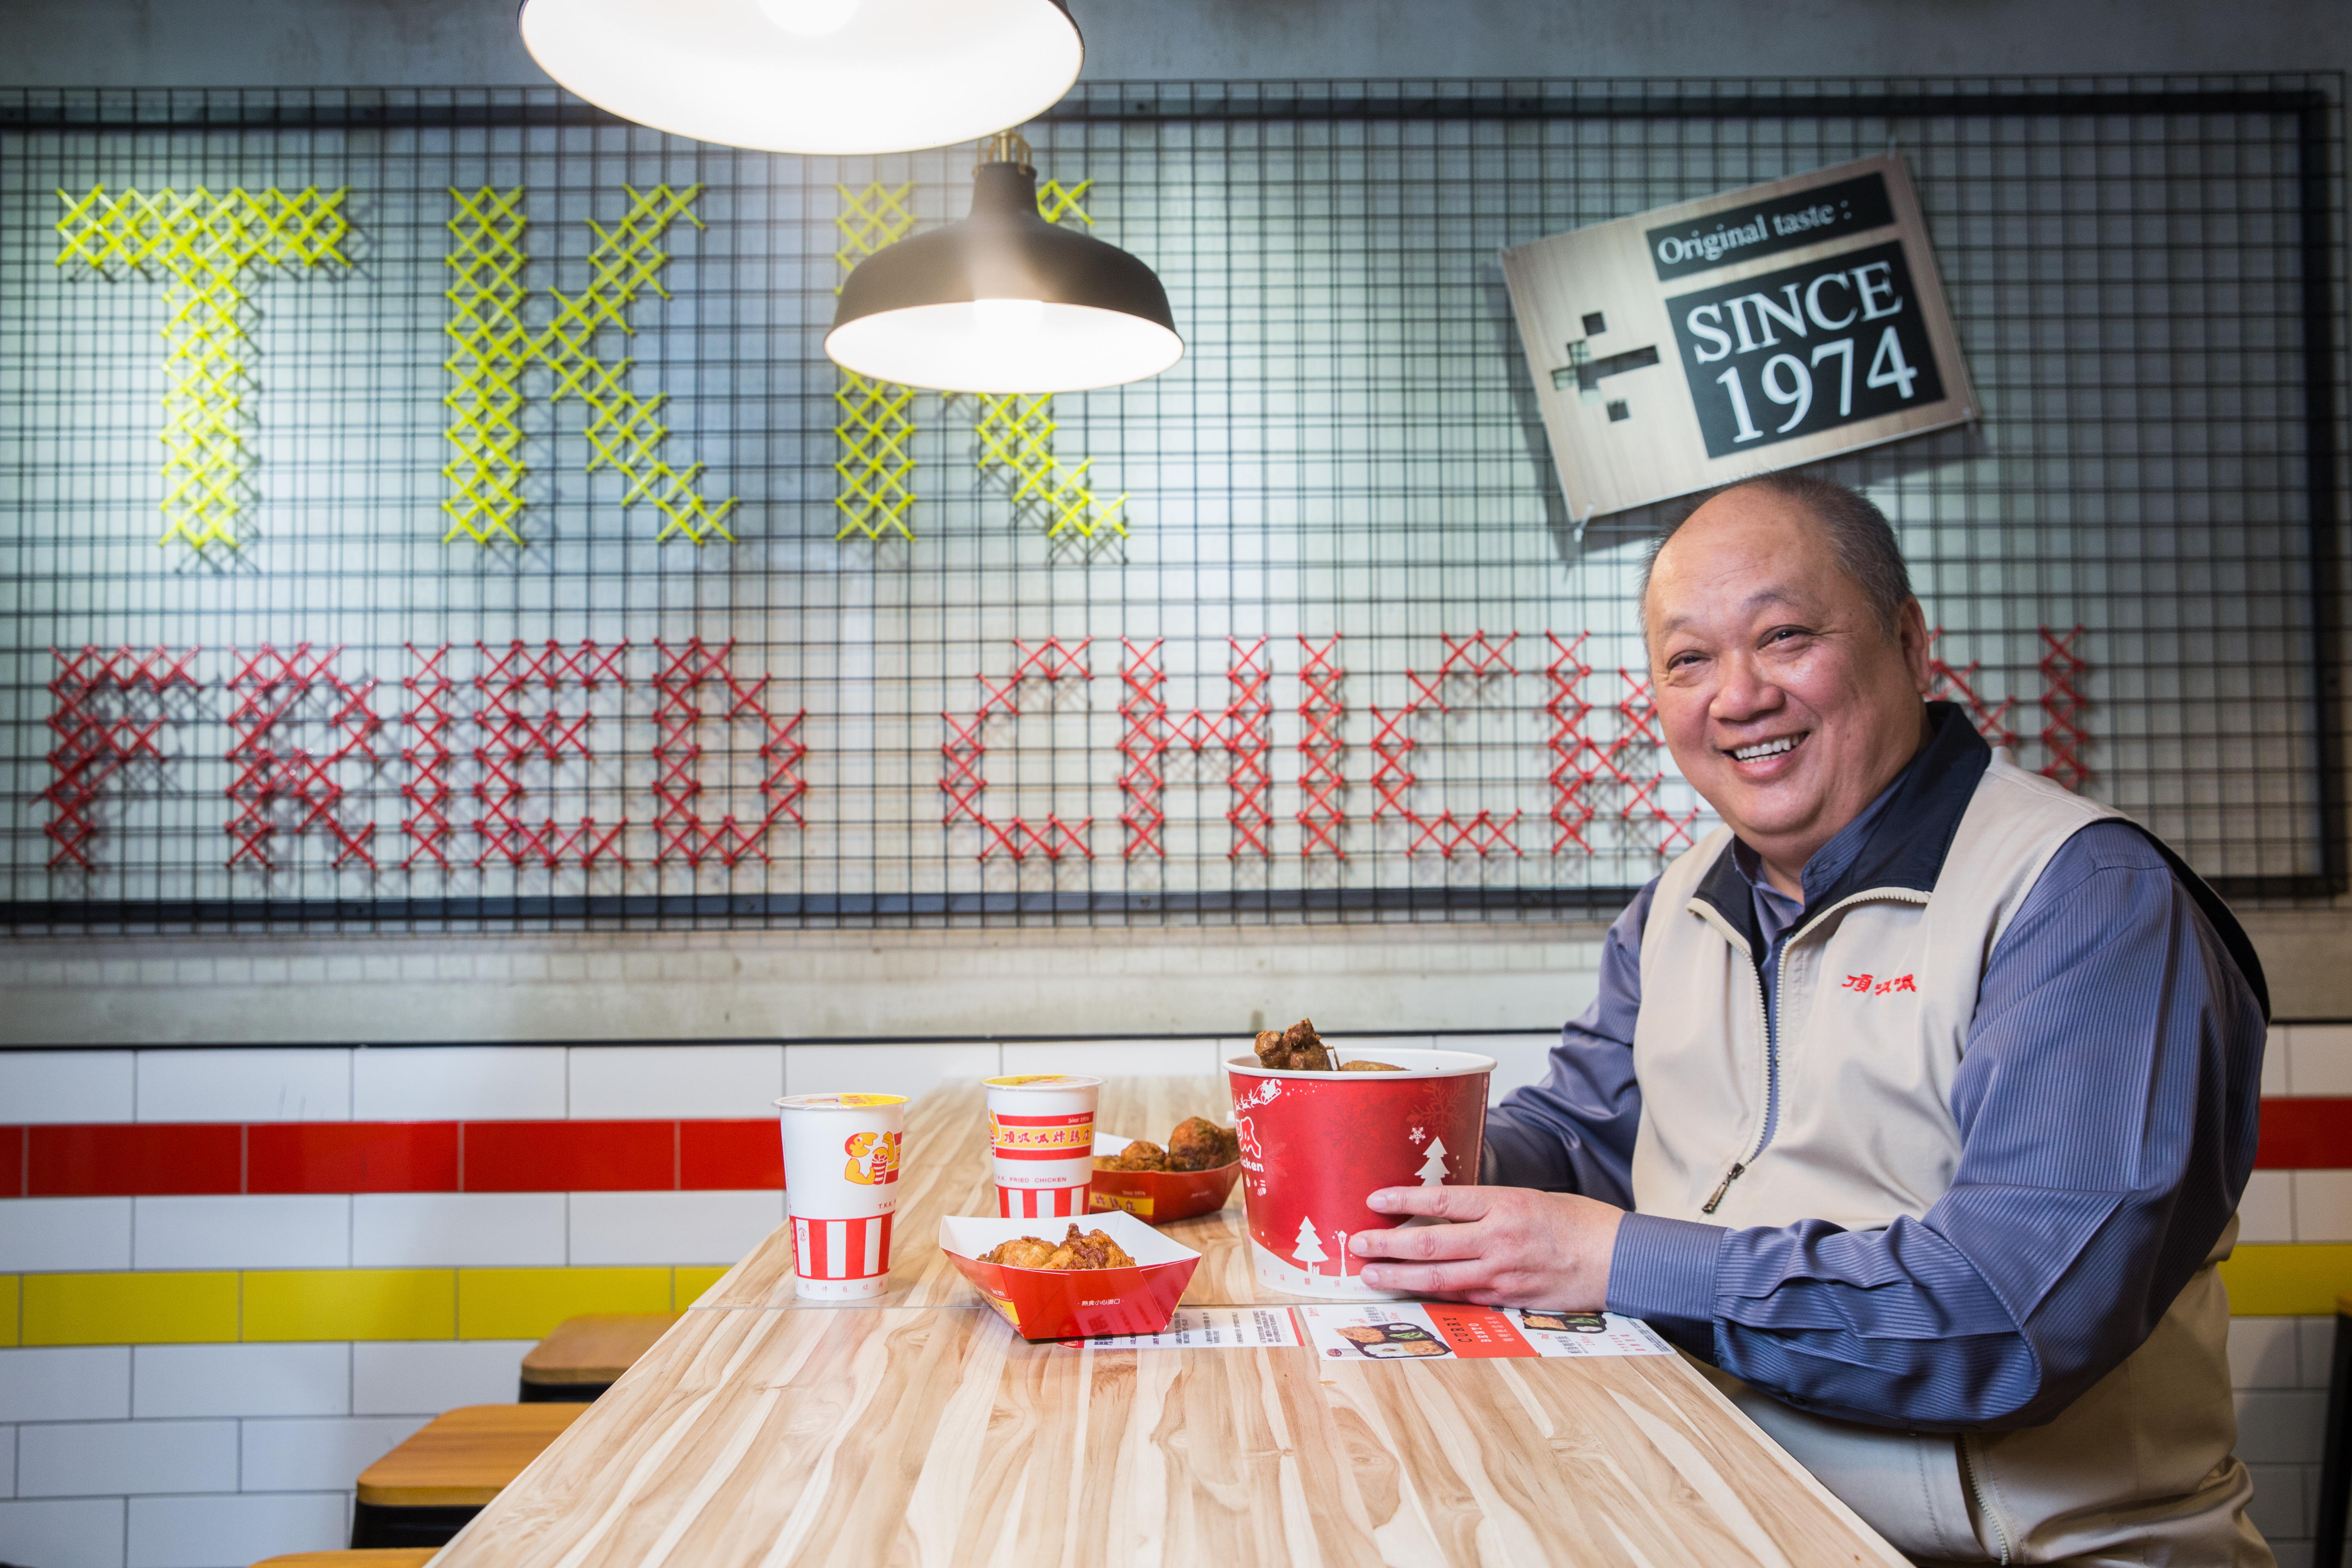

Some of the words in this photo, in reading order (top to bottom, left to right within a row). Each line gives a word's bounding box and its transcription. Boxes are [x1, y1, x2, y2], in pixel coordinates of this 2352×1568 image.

[1658, 214, 1769, 265] Original
[1686, 260, 1903, 365] SINCE
[1716, 325, 1918, 443] 1974
[46, 638, 807, 871] FRIED
[1841, 973, 1917, 996] 頂呱呱
[1443, 1317, 1472, 1343] CURRY
[1468, 1323, 1492, 1343] BENTO
